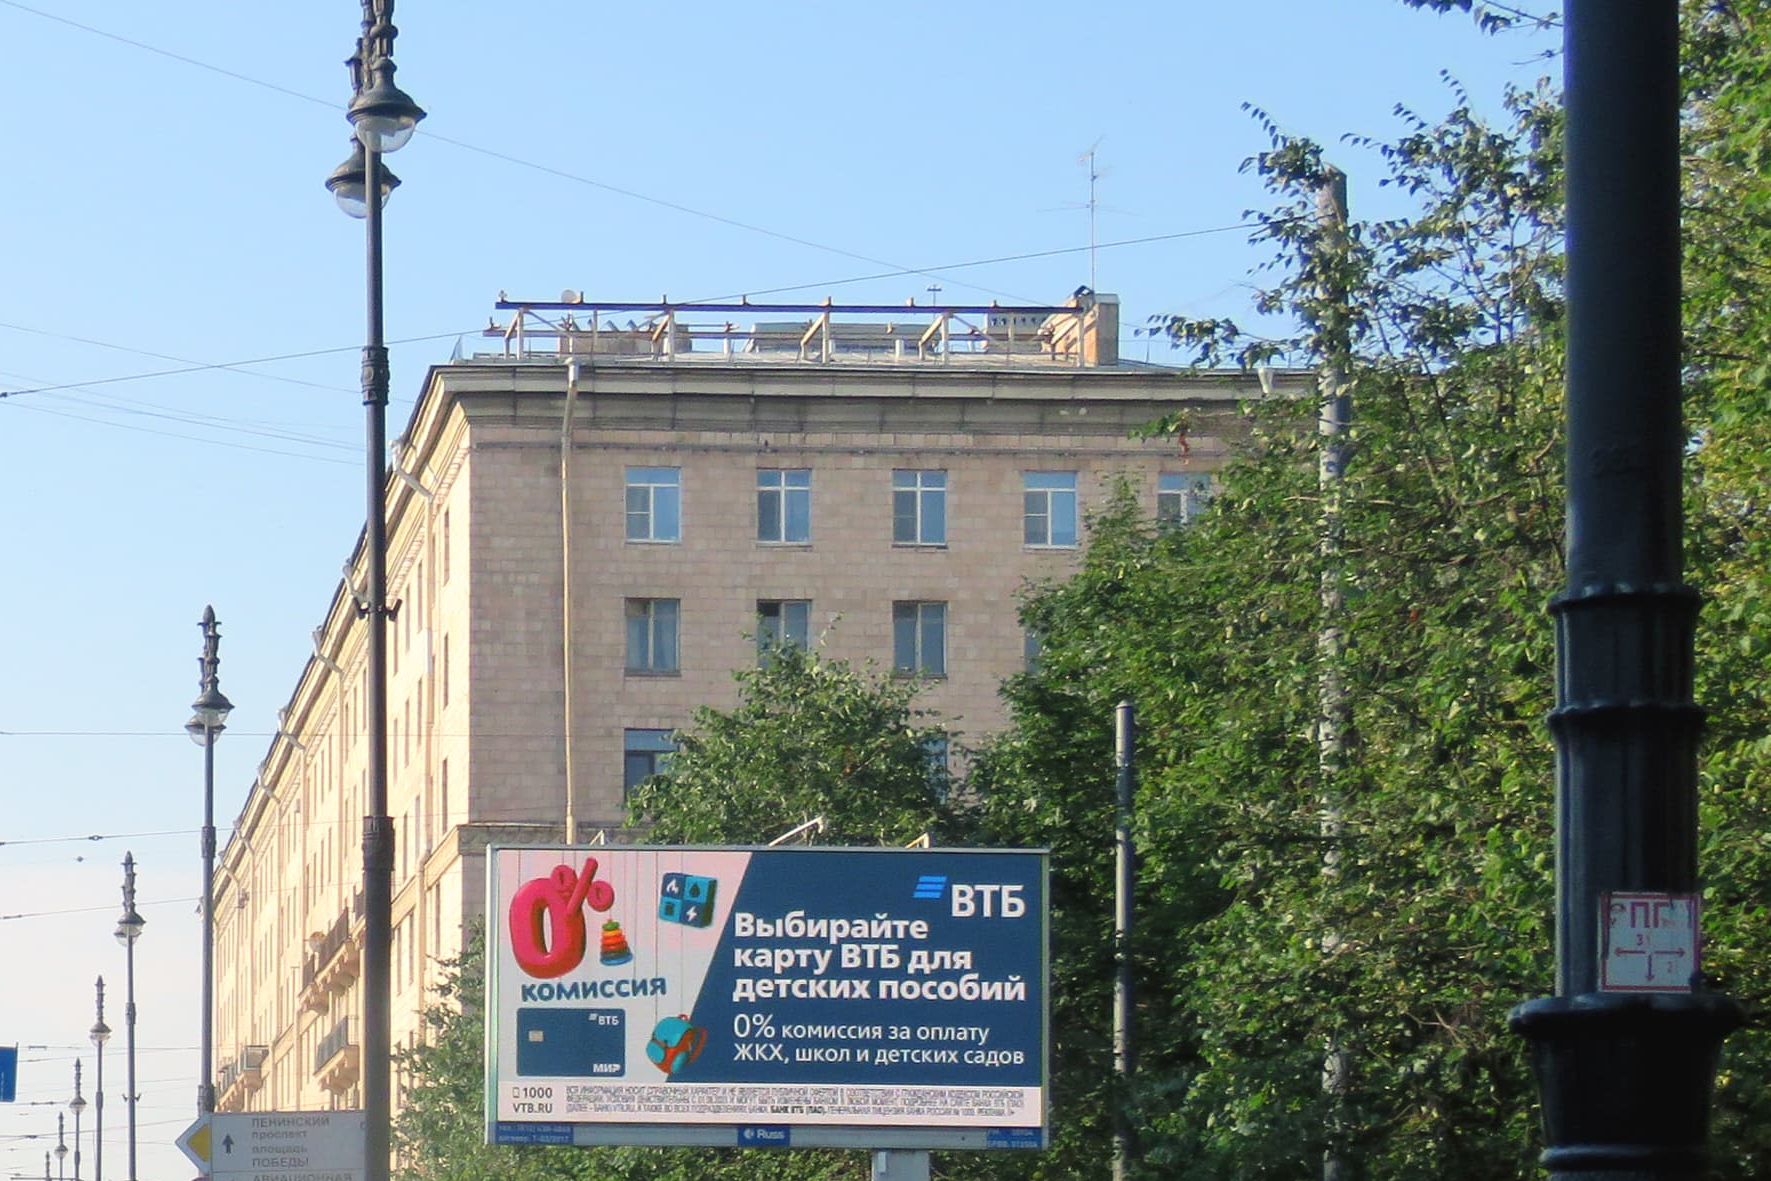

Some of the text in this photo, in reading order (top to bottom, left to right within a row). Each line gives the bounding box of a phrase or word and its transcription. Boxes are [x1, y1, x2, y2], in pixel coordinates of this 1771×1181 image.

[951, 884, 1026, 918] ВТБ
[509, 857, 615, 979] 0%
[734, 910, 929, 945] Выбирайте
[734, 943, 972, 975] карту ВТБ для
[732, 973, 1026, 1002] детских пособий
[598, 1016, 619, 1025] ВТБ
[733, 1013, 990, 1045] 0% комиссия за оплату
[733, 1043, 1025, 1067] ЖКХ, школ и детских садов
[593, 1063, 620, 1073] МИР
[522, 1087, 553, 1099] 1000
[513, 1103, 553, 1113] VTB.RU
[252, 1117, 330, 1128] ЛЕНИНСКИЙ
[252, 1130, 307, 1140] проспект
[757, 1129, 785, 1139] Russ
[252, 1157, 308, 1168] ПОБЕДЫ
